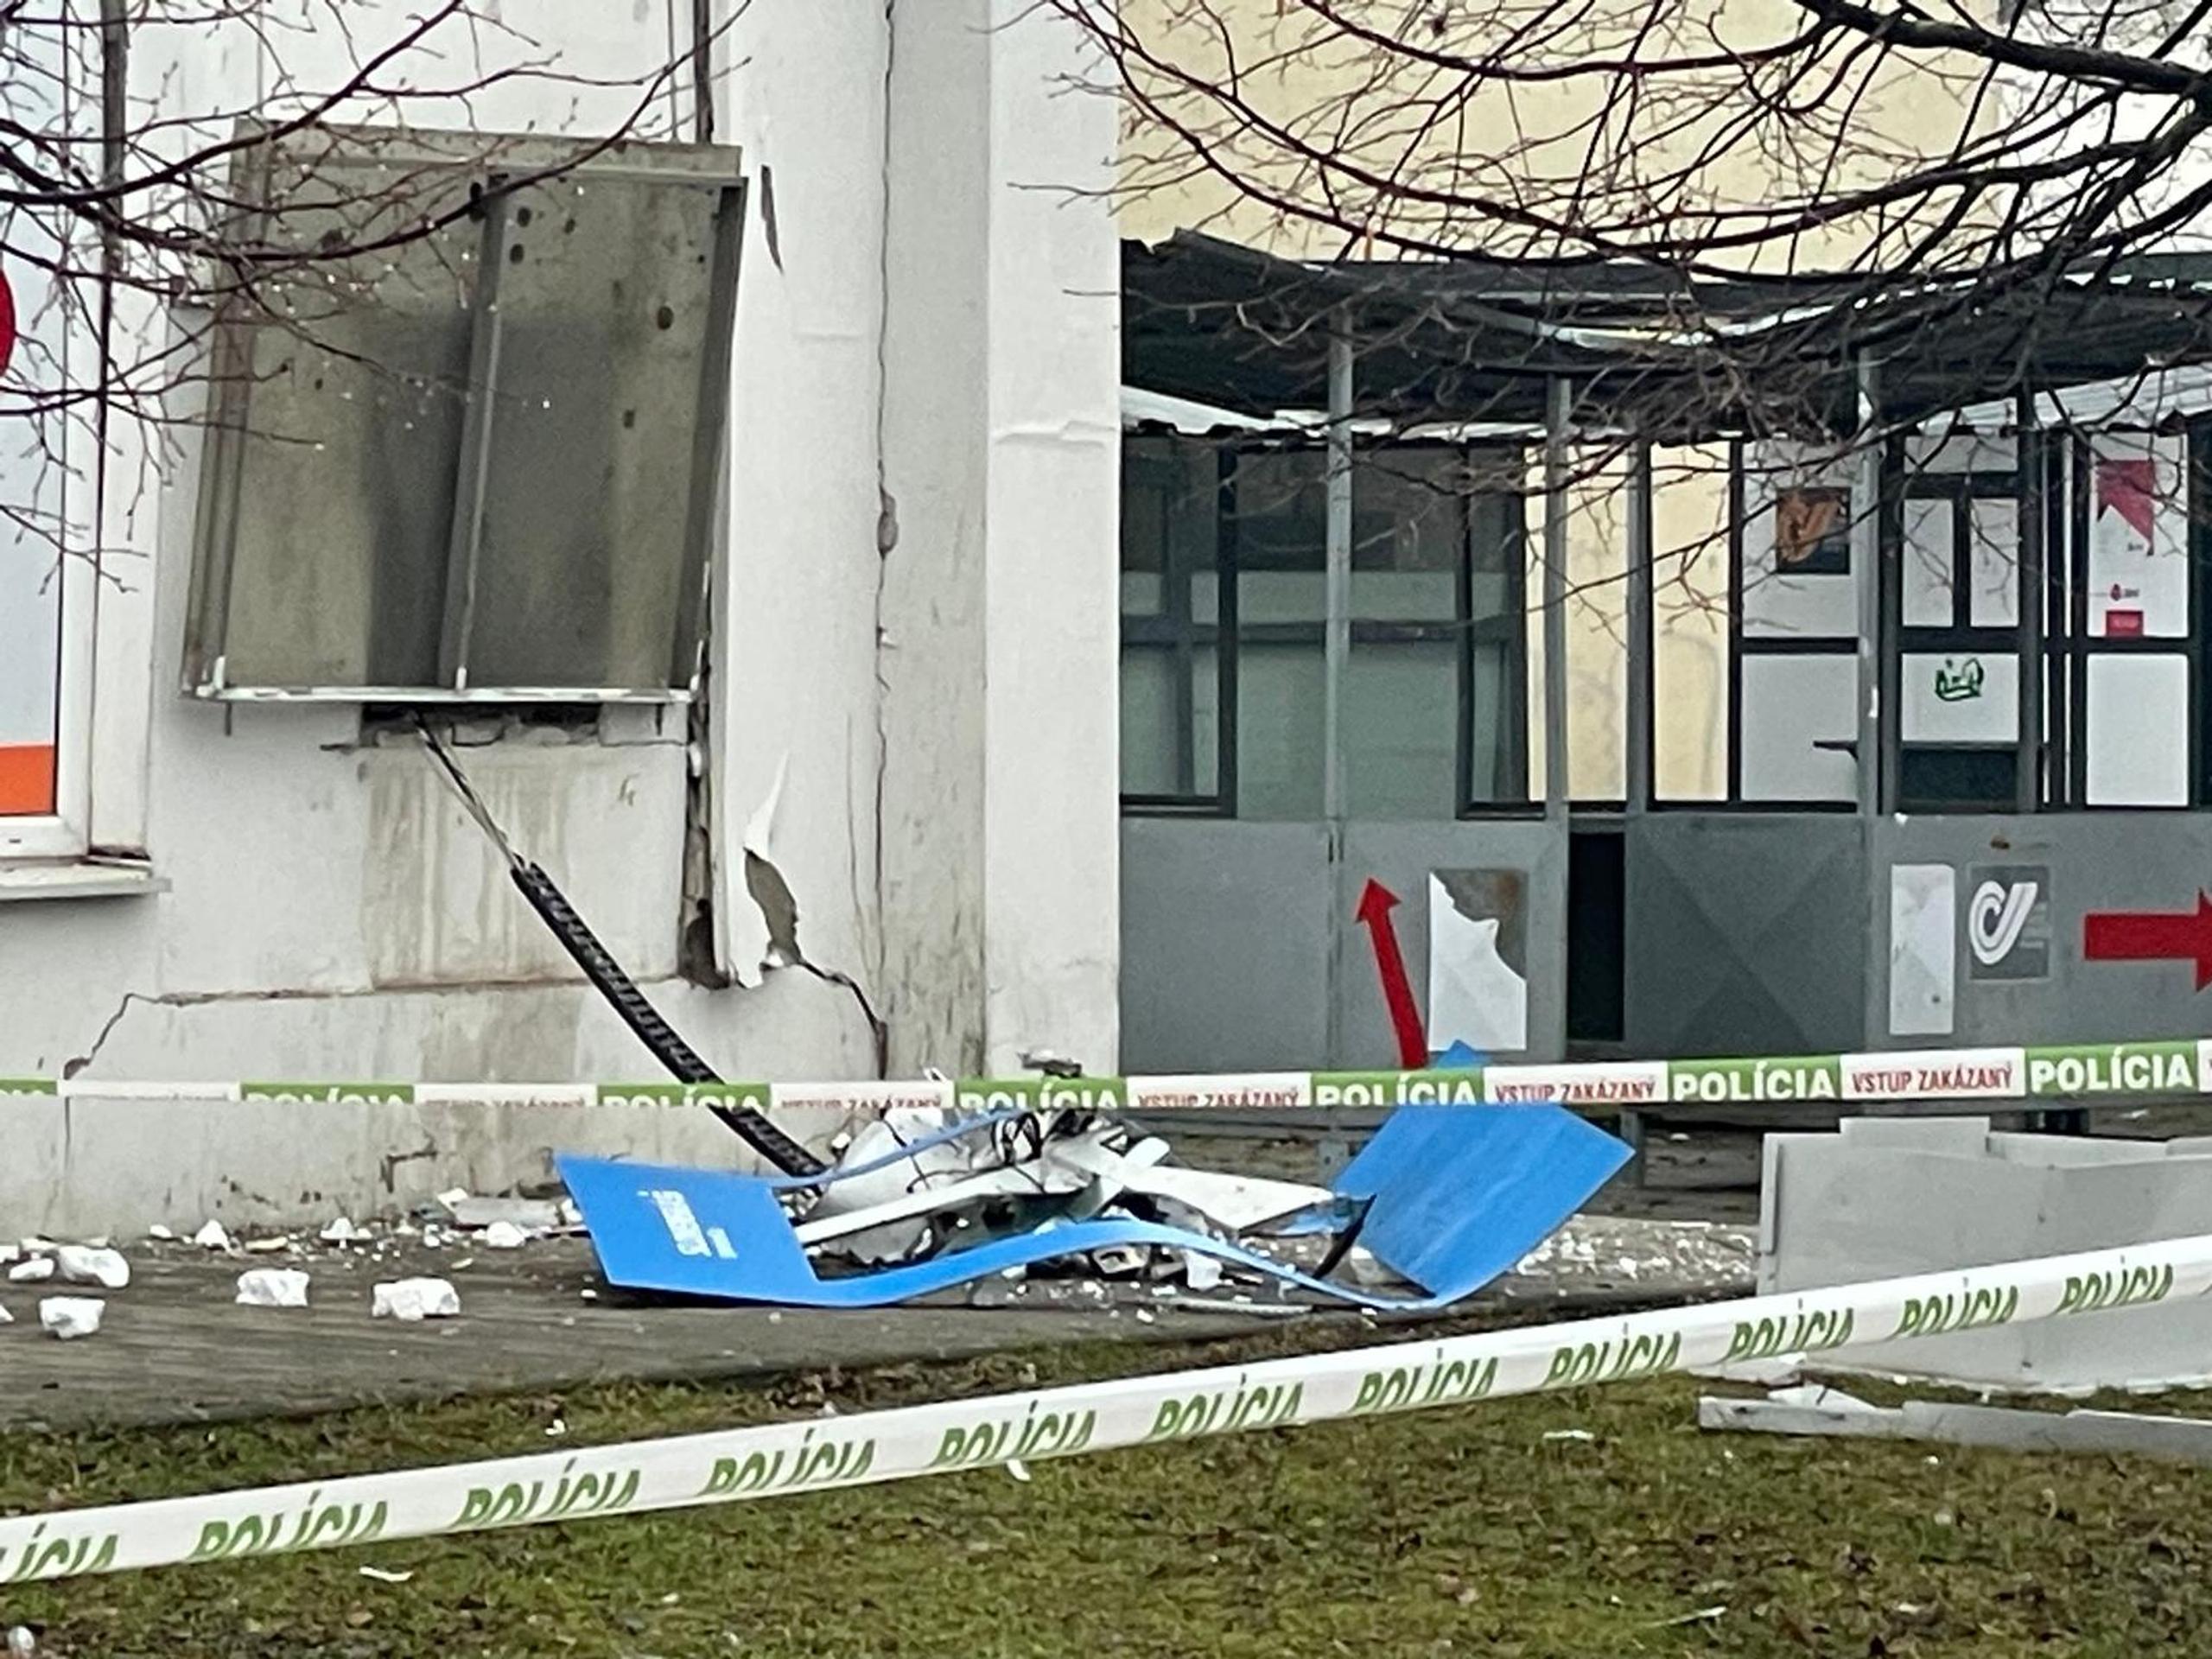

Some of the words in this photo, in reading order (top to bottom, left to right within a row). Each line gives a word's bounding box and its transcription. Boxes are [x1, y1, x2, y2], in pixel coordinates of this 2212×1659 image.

[1316, 1073, 1477, 1106] POLÍCIA
[1495, 1084, 1554, 1104] VSTUP
[1560, 1074, 1655, 1101] ZAKÁZANÝ
[1674, 1061, 1836, 1102] POLÍCIA
[1853, 1071, 1911, 1092] VSTUP
[1918, 1061, 2012, 1091] ZAKÁZANÝ
[2031, 1046, 2193, 1094] POLÍCIA
